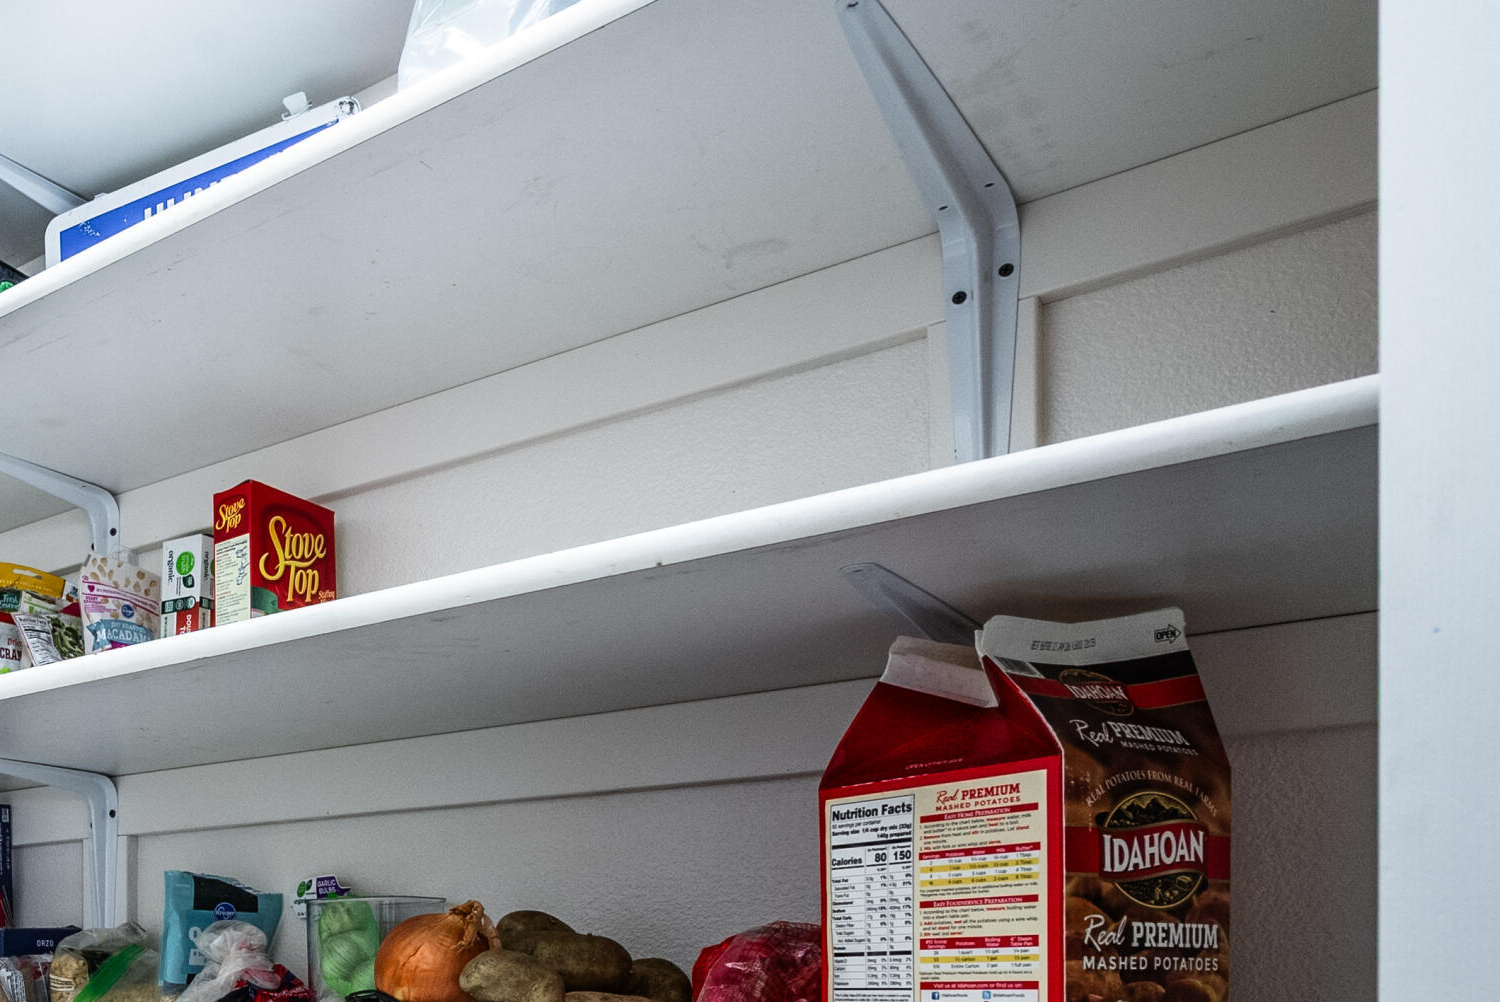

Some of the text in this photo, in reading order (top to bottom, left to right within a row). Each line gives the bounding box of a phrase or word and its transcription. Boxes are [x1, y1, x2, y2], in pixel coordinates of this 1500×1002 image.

[216, 497, 245, 531] Stove
[226, 514, 242, 533] Top
[259, 516, 327, 581] Stove
[275, 560, 320, 602] Top
[1156, 630, 1176, 640] OPEN
[1064, 683, 1128, 701] IDAHOAN
[1069, 719, 1190, 747] Real PREMIUM
[1121, 740, 1154, 752] MASHED
[1105, 770, 1146, 789] POTATOES
[1148, 771, 1172, 782] FROM
[1174, 776, 1193, 792] REAL
[936, 783, 1020, 805] Real PREMIUM
[936, 796, 1021, 812] MASHED POTATOES
[832, 802, 912, 821] Nutrition Facts
[831, 850, 911, 866] Calories 80 150
[1102, 828, 1204, 872] IDAHOAN
[1083, 914, 1219, 952] Real PREMIUM
[1083, 956, 1219, 971] MASHED POTATOES
